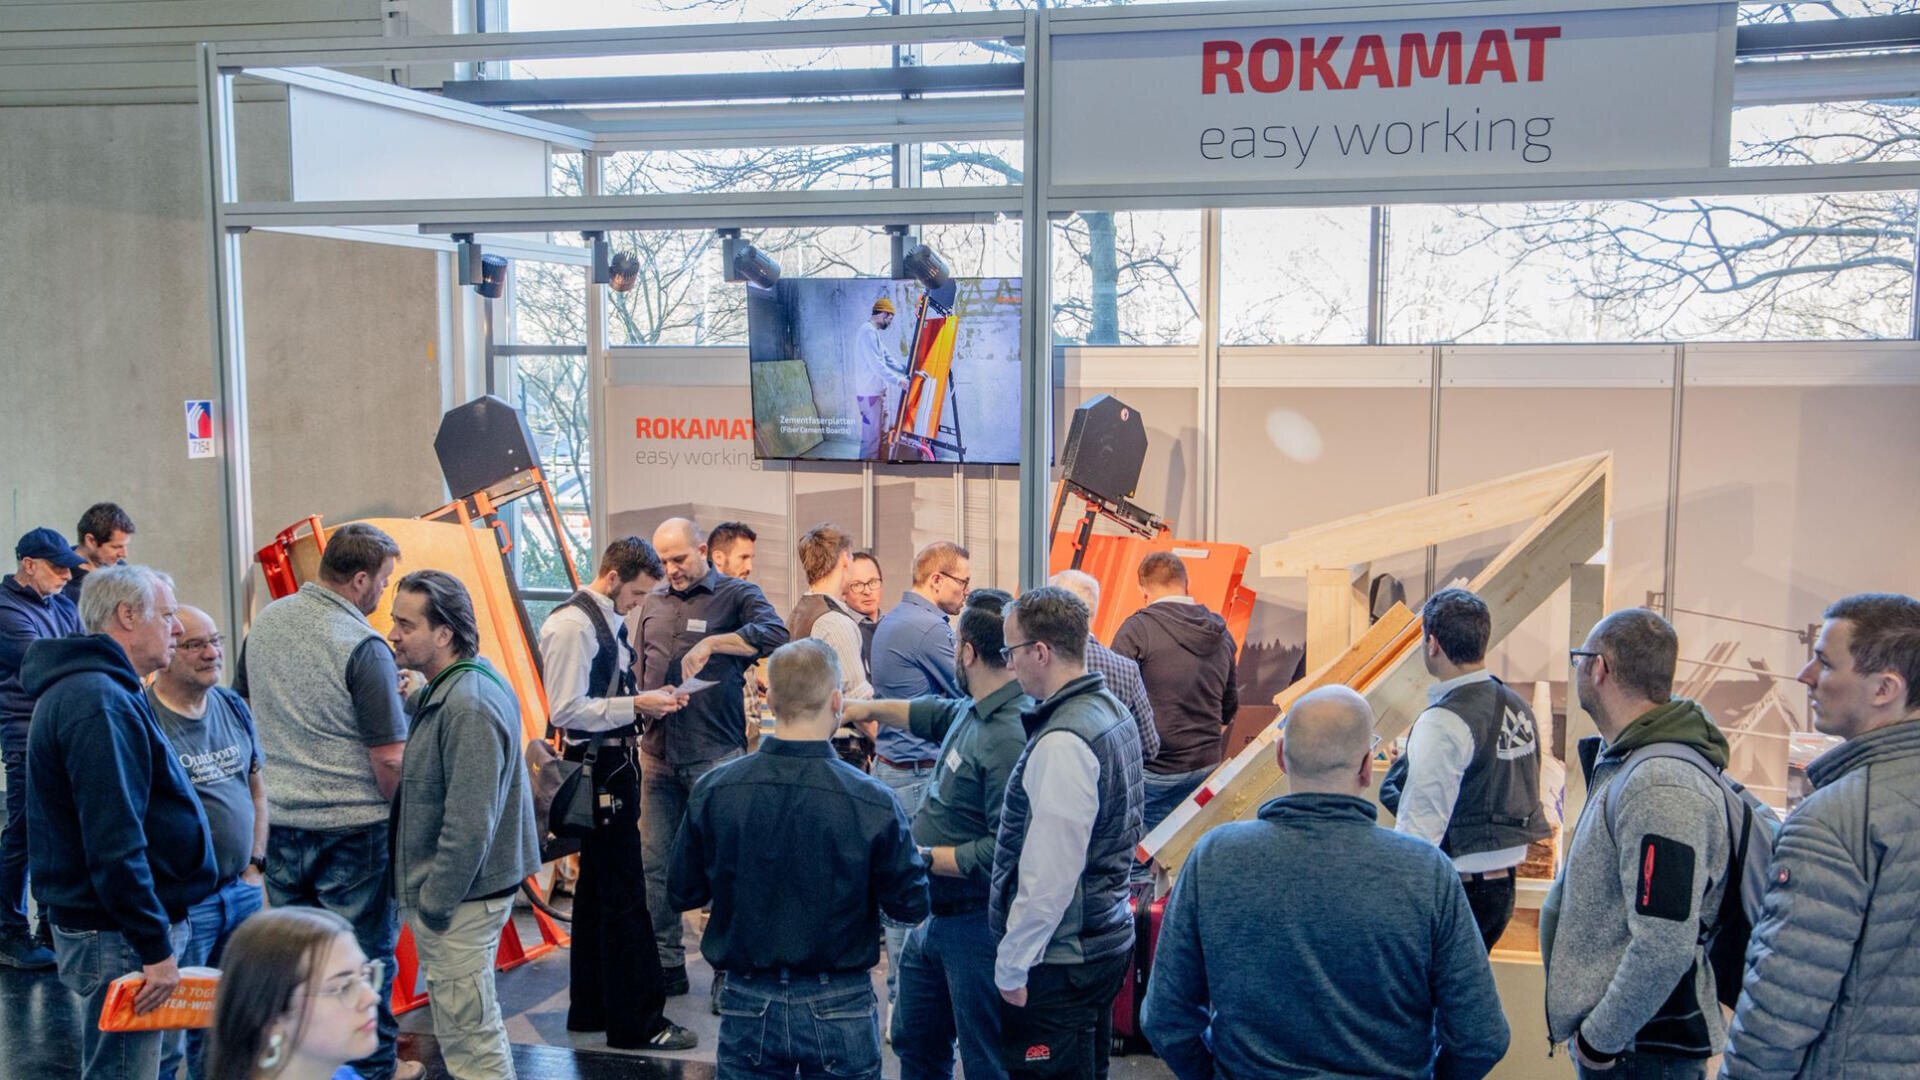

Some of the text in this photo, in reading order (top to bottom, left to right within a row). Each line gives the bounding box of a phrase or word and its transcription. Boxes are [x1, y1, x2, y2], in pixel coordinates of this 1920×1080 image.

[1201, 25, 1562, 95] ROKAMAT
[1200, 106, 1555, 170] easy working
[635, 448, 761, 471] easy working
[189, 987, 217, 999] TOGE
